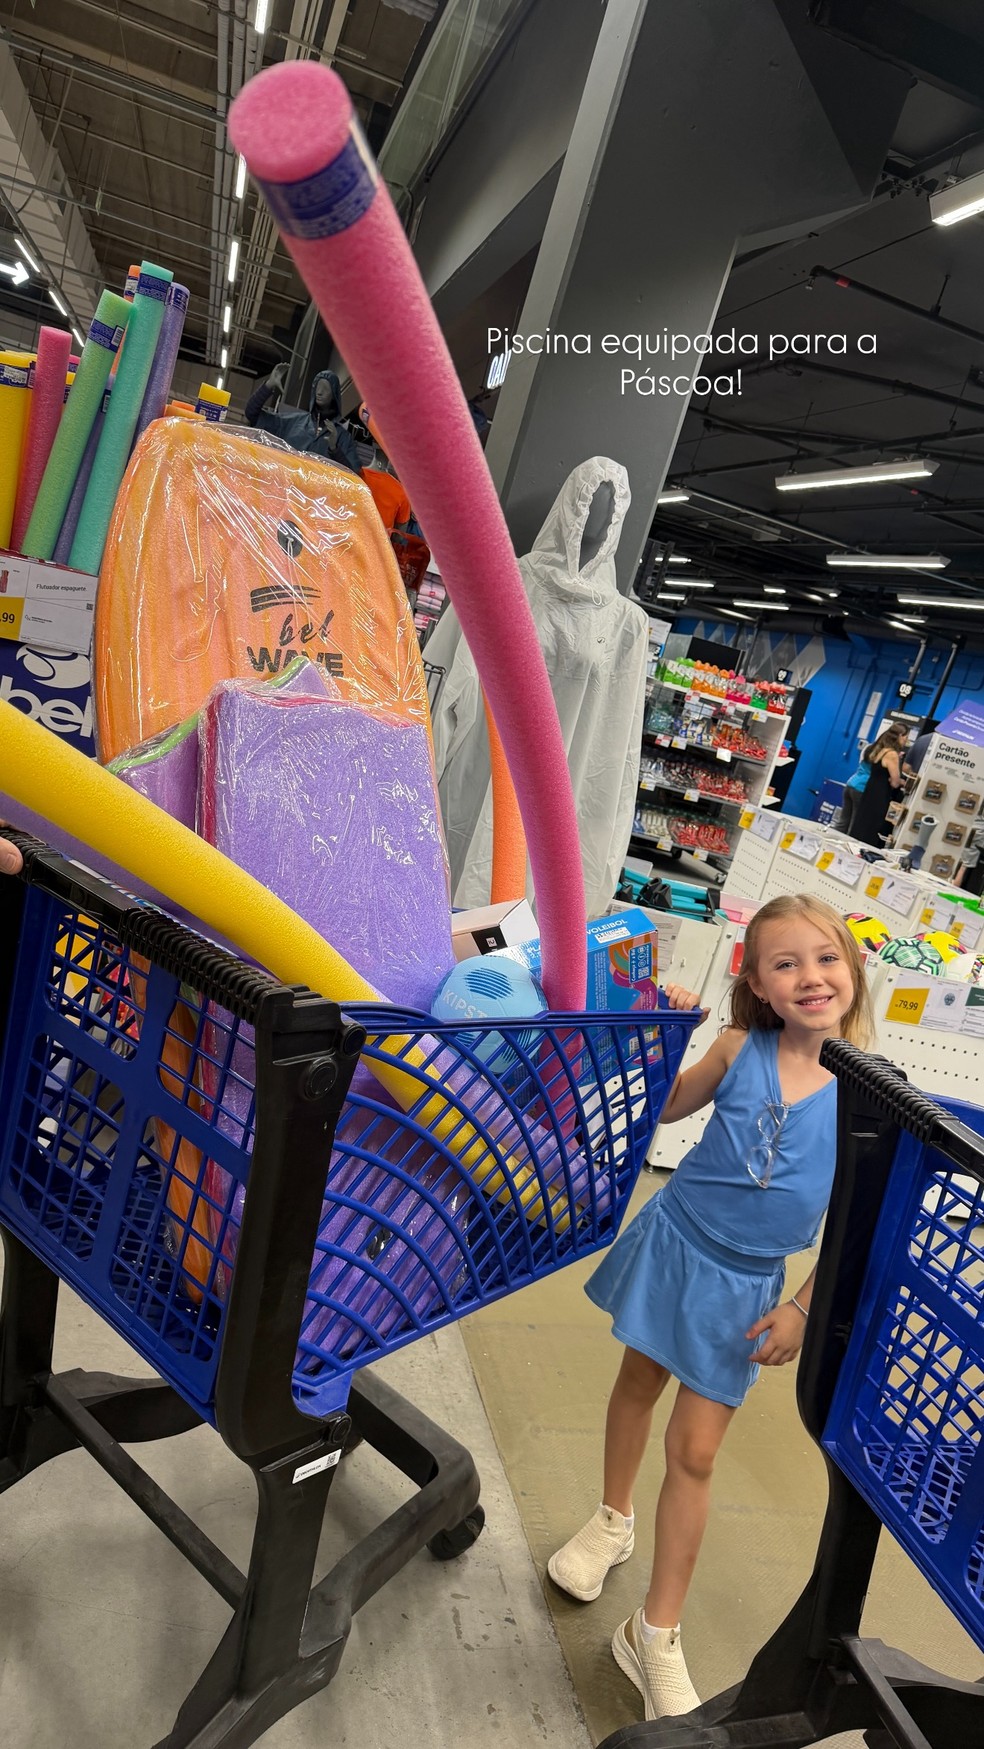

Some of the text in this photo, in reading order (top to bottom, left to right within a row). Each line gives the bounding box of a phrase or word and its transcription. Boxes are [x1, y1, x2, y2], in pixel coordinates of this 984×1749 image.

[899, 683, 912, 695] 08
[939, 742, 970, 758] Cartão
[935, 751, 976, 769] presente
[898, 999, 919, 1010] 79,99
